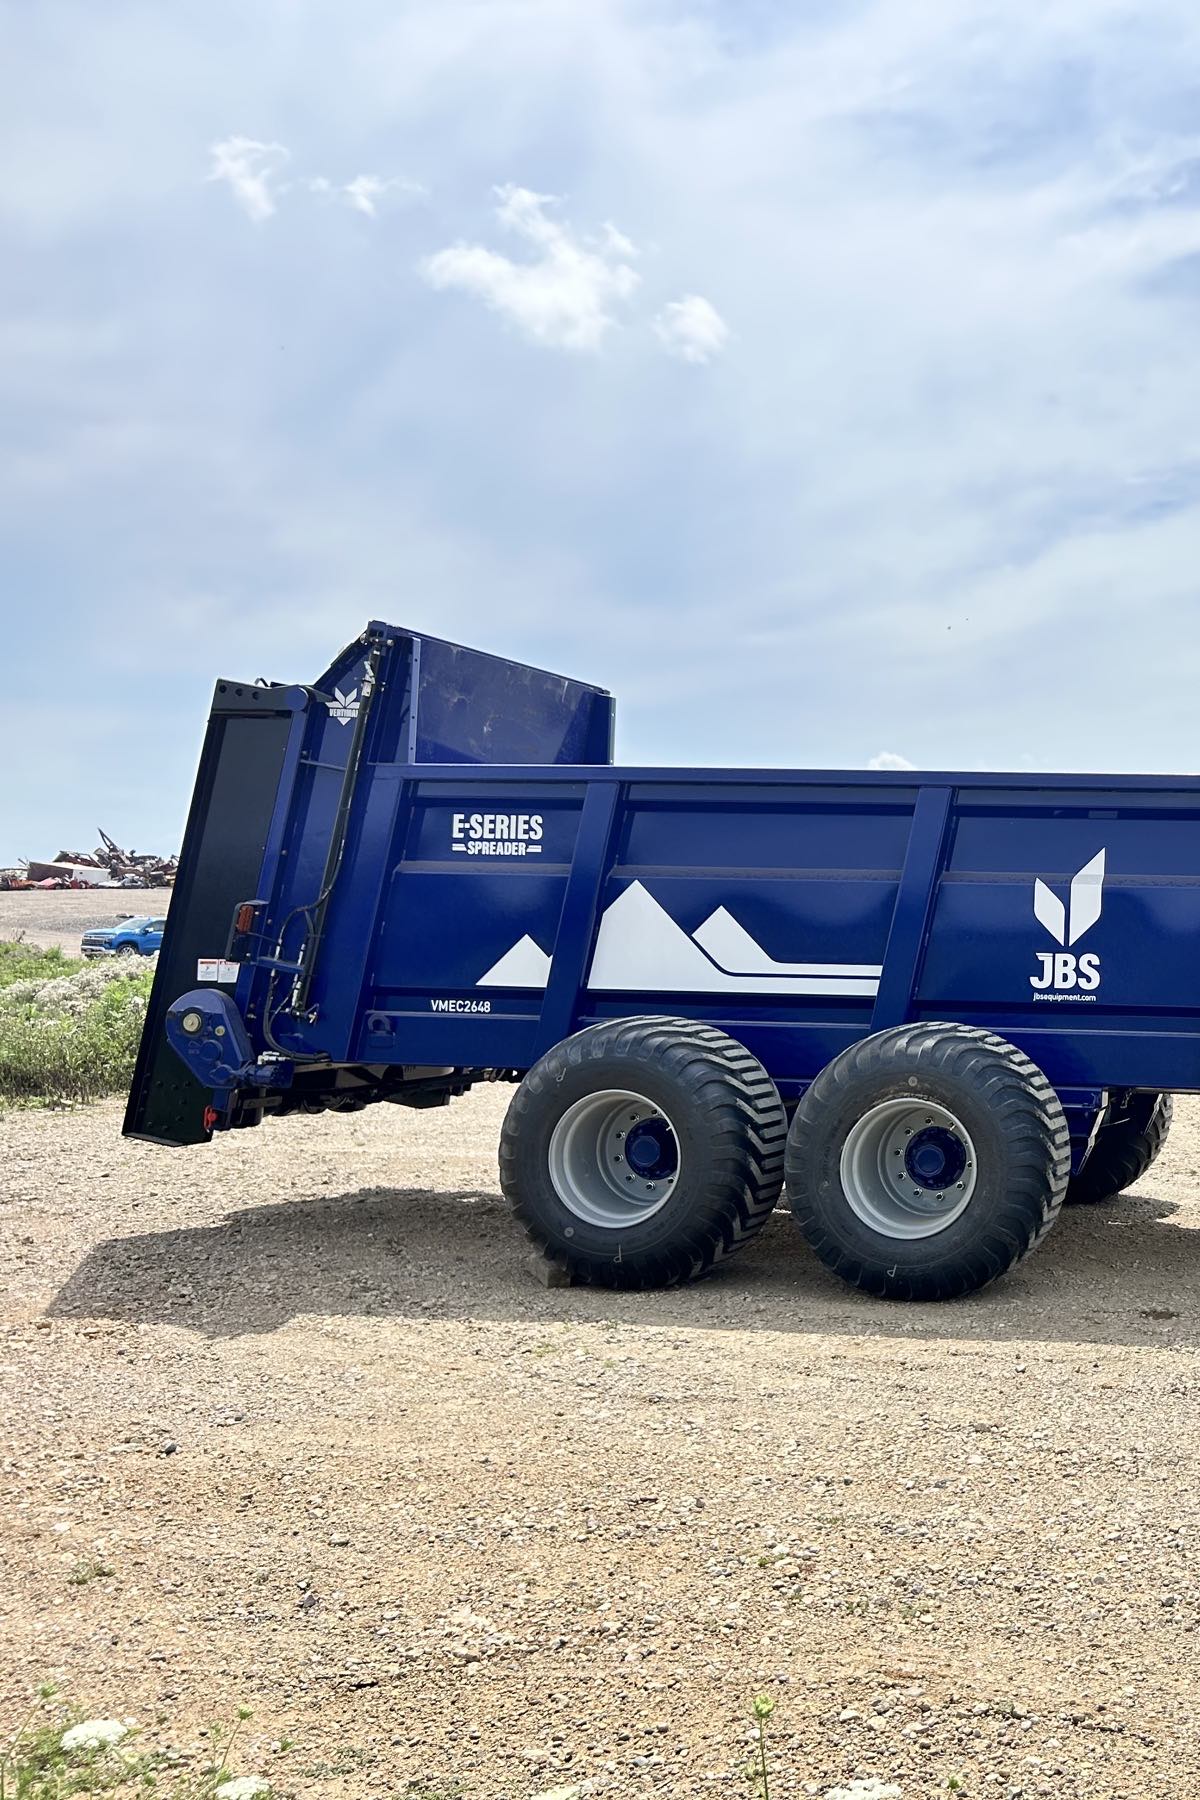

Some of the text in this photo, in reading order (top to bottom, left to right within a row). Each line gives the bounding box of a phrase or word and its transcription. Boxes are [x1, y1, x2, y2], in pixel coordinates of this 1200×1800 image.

[452, 813, 543, 840] E-SERIES
[467, 841, 526, 855] SPREADER
[1029, 952, 1101, 991] JBS
[1032, 992, 1097, 1002] jbsequipment.com
[431, 999, 491, 1013] VMEC2648
